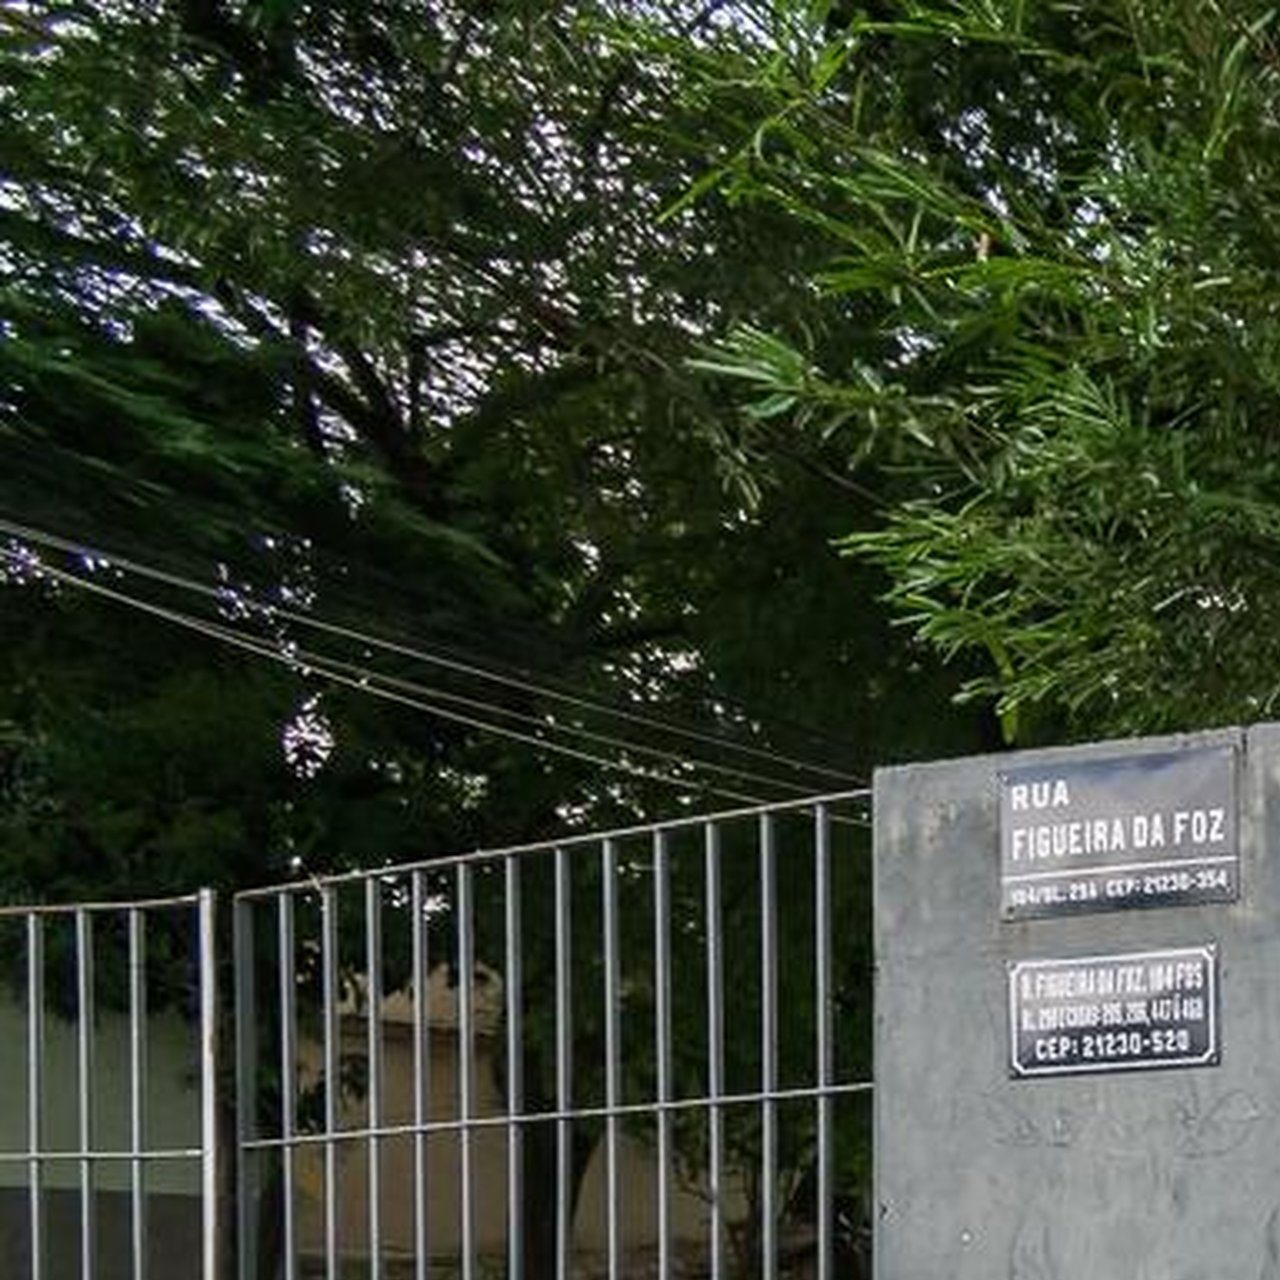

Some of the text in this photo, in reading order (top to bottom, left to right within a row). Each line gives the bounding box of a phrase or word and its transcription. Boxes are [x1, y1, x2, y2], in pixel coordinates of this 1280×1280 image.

[1011, 780, 1070, 811] RUA
[1012, 808, 1225, 861] FIGUEIRA DA FOZ
[1035, 1029, 1190, 1061] CEP: 21230-520
